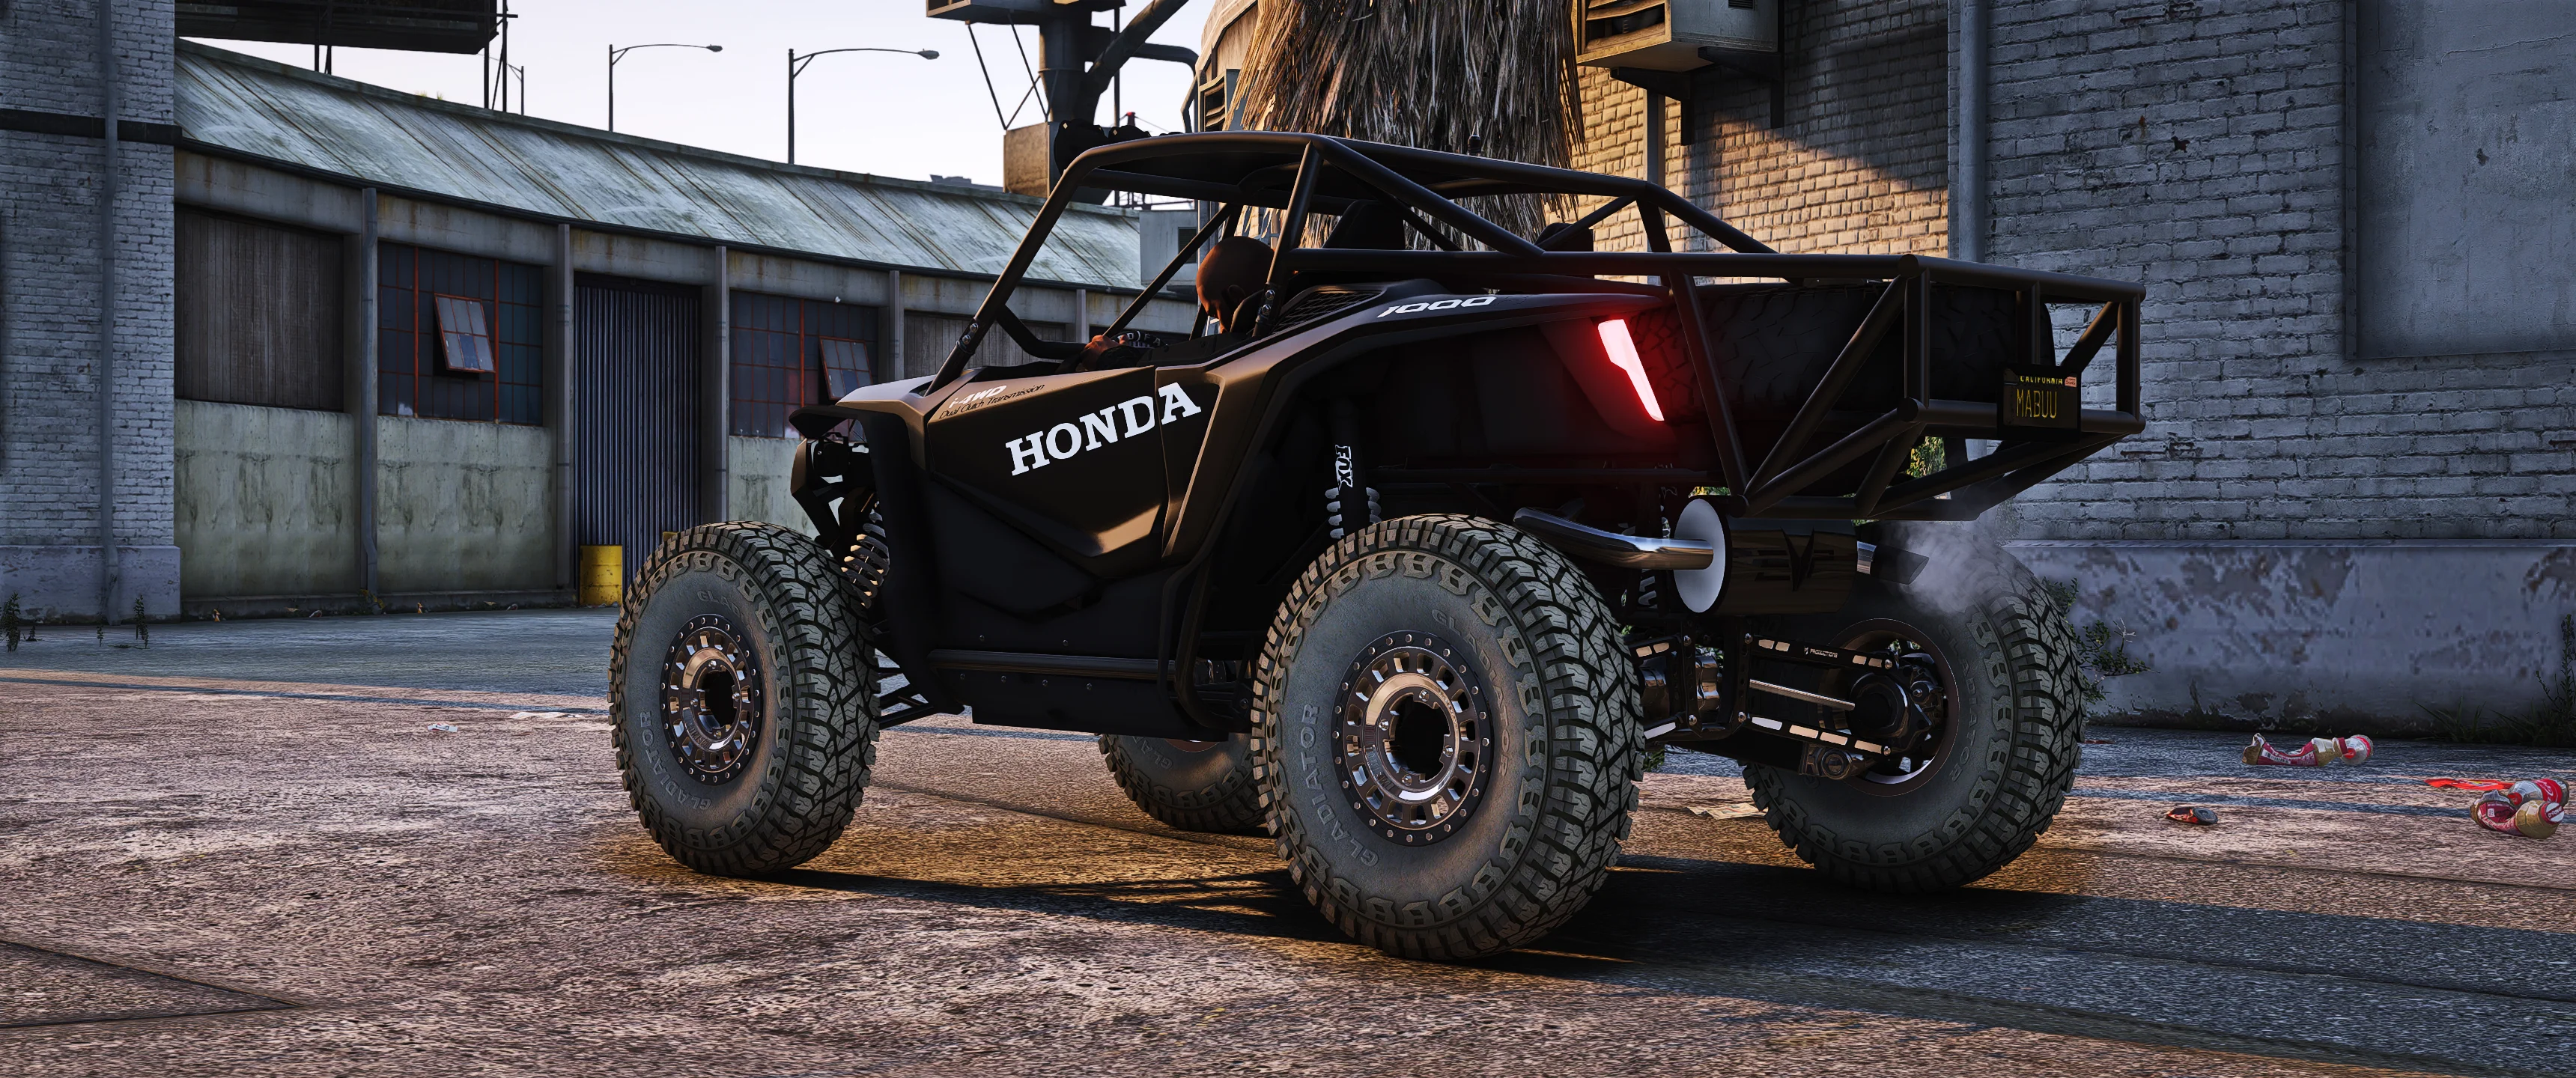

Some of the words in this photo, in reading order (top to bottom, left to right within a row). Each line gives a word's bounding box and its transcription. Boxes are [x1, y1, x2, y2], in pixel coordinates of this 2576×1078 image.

[1376, 296, 1498, 318] 1000
[939, 406, 962, 419] Dual
[961, 399, 985, 412] Clutch
[986, 383, 1046, 405] Transmission
[2017, 389, 2058, 419] MABUU
[2020, 375, 2064, 385] CALIFORNIA
[1005, 382, 1202, 476] HONDA
[1432, 607, 1511, 778] GLADIATOR
[639, 710, 712, 811] GLADIATOR
[1301, 704, 1379, 868] GLADIATOR
